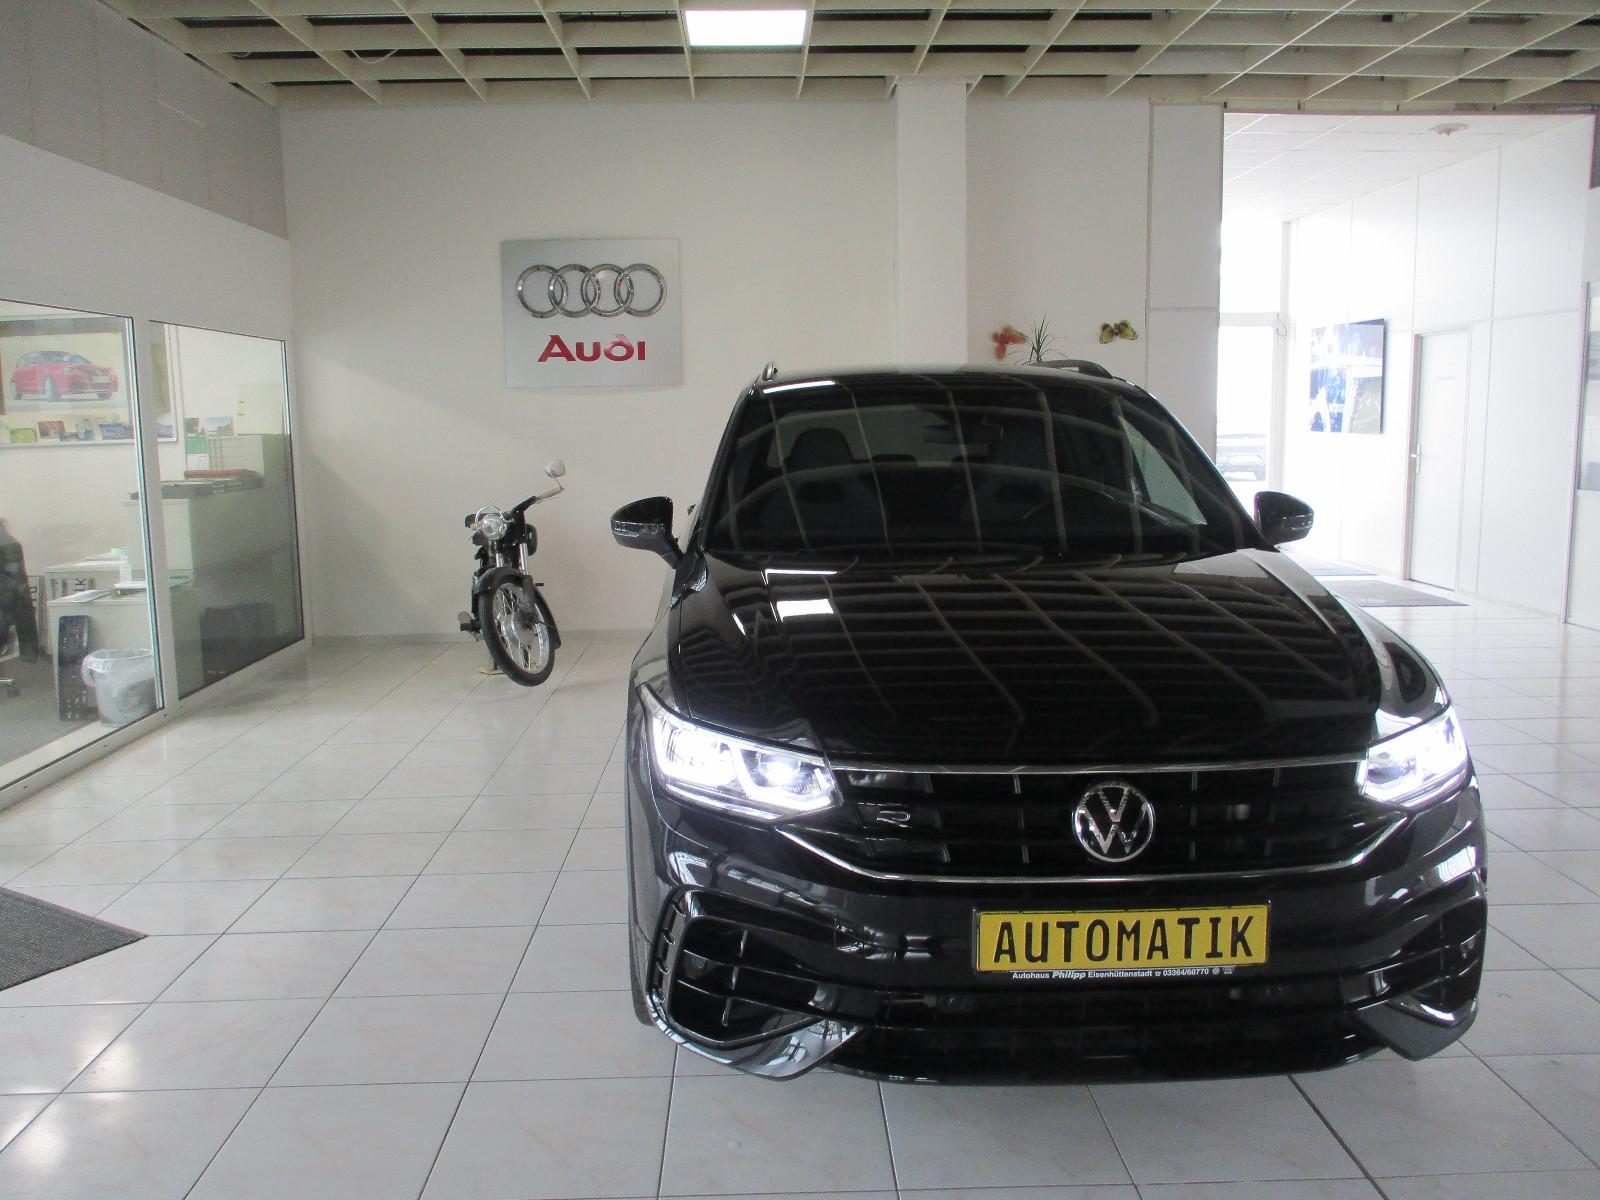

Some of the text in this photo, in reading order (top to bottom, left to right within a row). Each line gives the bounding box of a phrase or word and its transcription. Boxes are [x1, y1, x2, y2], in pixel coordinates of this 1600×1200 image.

[993, 915, 1254, 964] AUTOMATIK
[1012, 971, 1050, 980] Autohaus
[1052, 969, 1087, 980] Philipp
[1087, 968, 1153, 979] Eisenhüttenstadt
